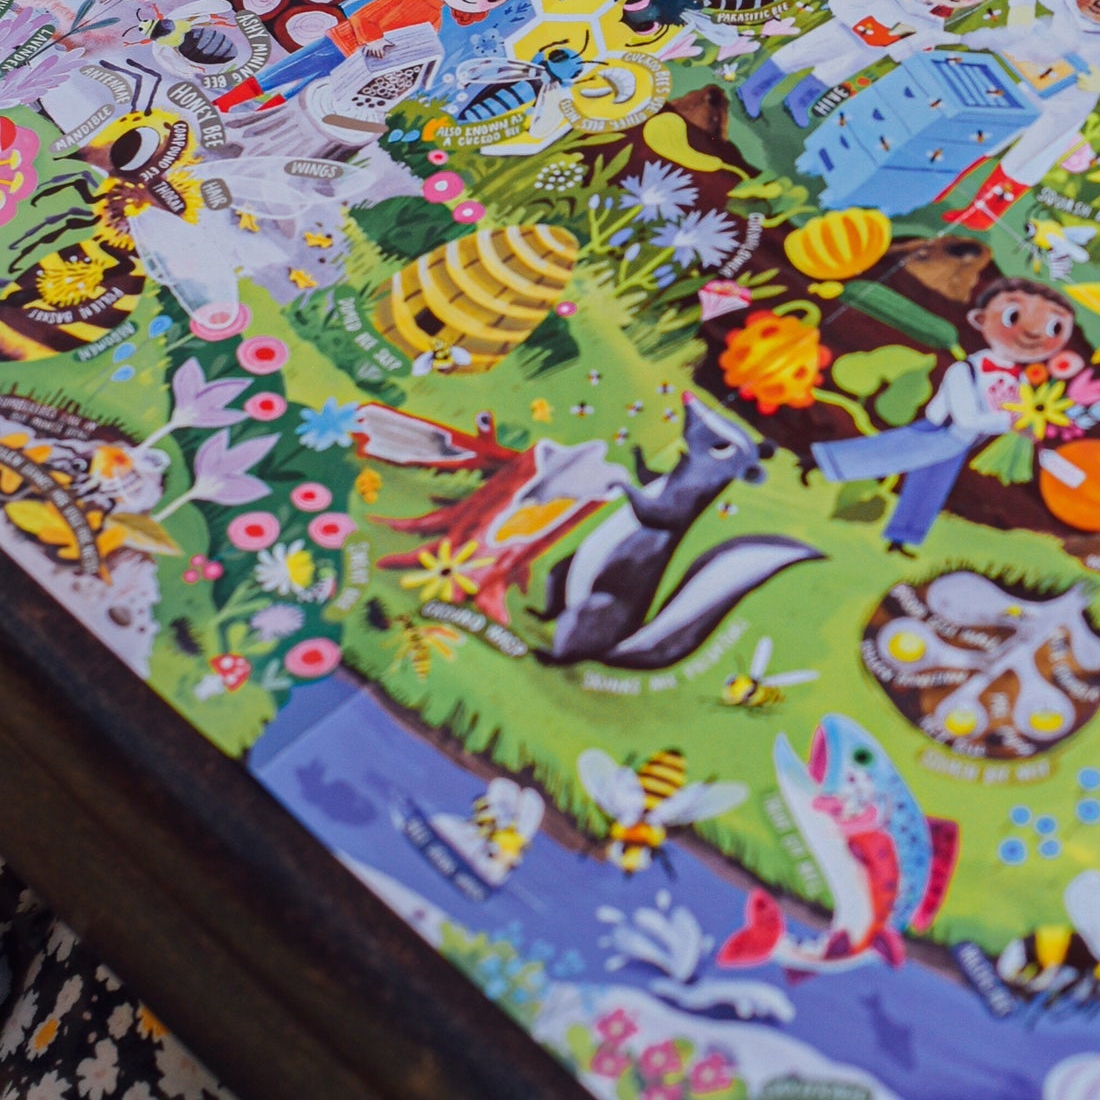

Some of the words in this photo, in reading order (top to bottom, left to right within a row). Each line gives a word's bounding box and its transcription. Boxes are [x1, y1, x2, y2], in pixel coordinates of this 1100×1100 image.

[238, 13, 261, 40] ASHY
[2, 30, 54, 73] LAVENDER
[231, 42, 269, 82] MINING
[82, 66, 131, 104] ANTENNAE
[204, 76, 227, 88] BEE
[813, 86, 850, 116] HIVE
[54, 105, 112, 151] MANDIBLE
[170, 82, 213, 123] HONEY
[202, 120, 224, 148] BEE
[159, 123, 188, 169] COMPOUND
[289, 161, 339, 179] WINGS
